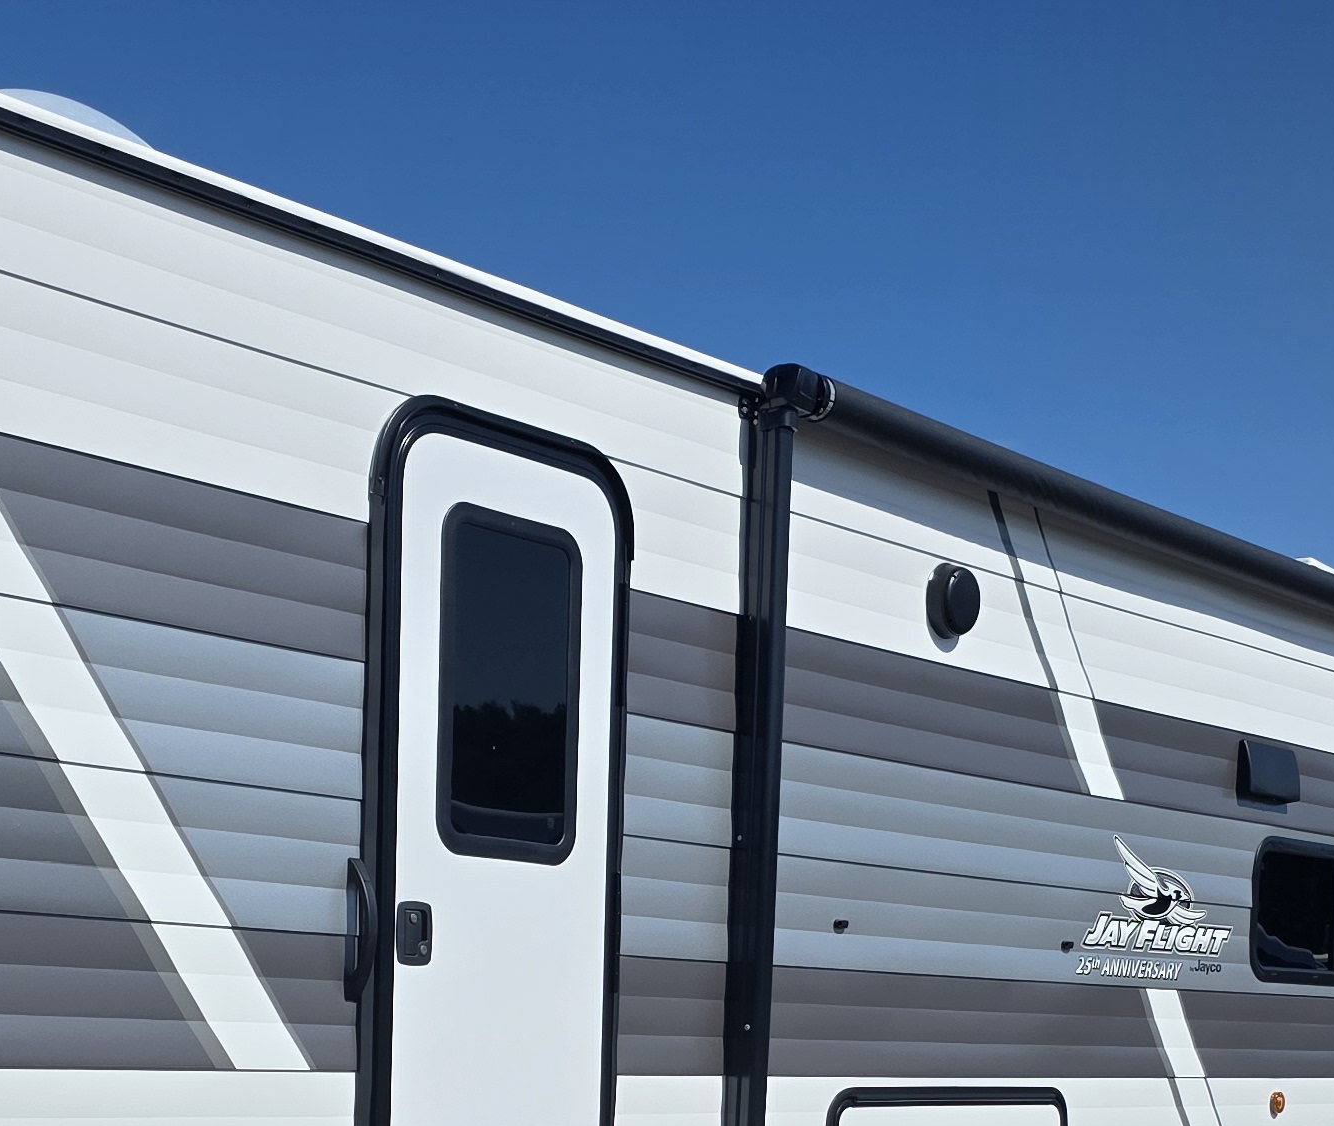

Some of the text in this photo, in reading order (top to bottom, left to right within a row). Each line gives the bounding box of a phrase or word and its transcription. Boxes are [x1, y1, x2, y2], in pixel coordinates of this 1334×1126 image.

[1081, 911, 1233, 957] JAY FLIGHT
[1075, 956, 1101, 975] 25th
[1100, 957, 1183, 981] ANNIVERSARY
[1194, 959, 1222, 976] Jayco
